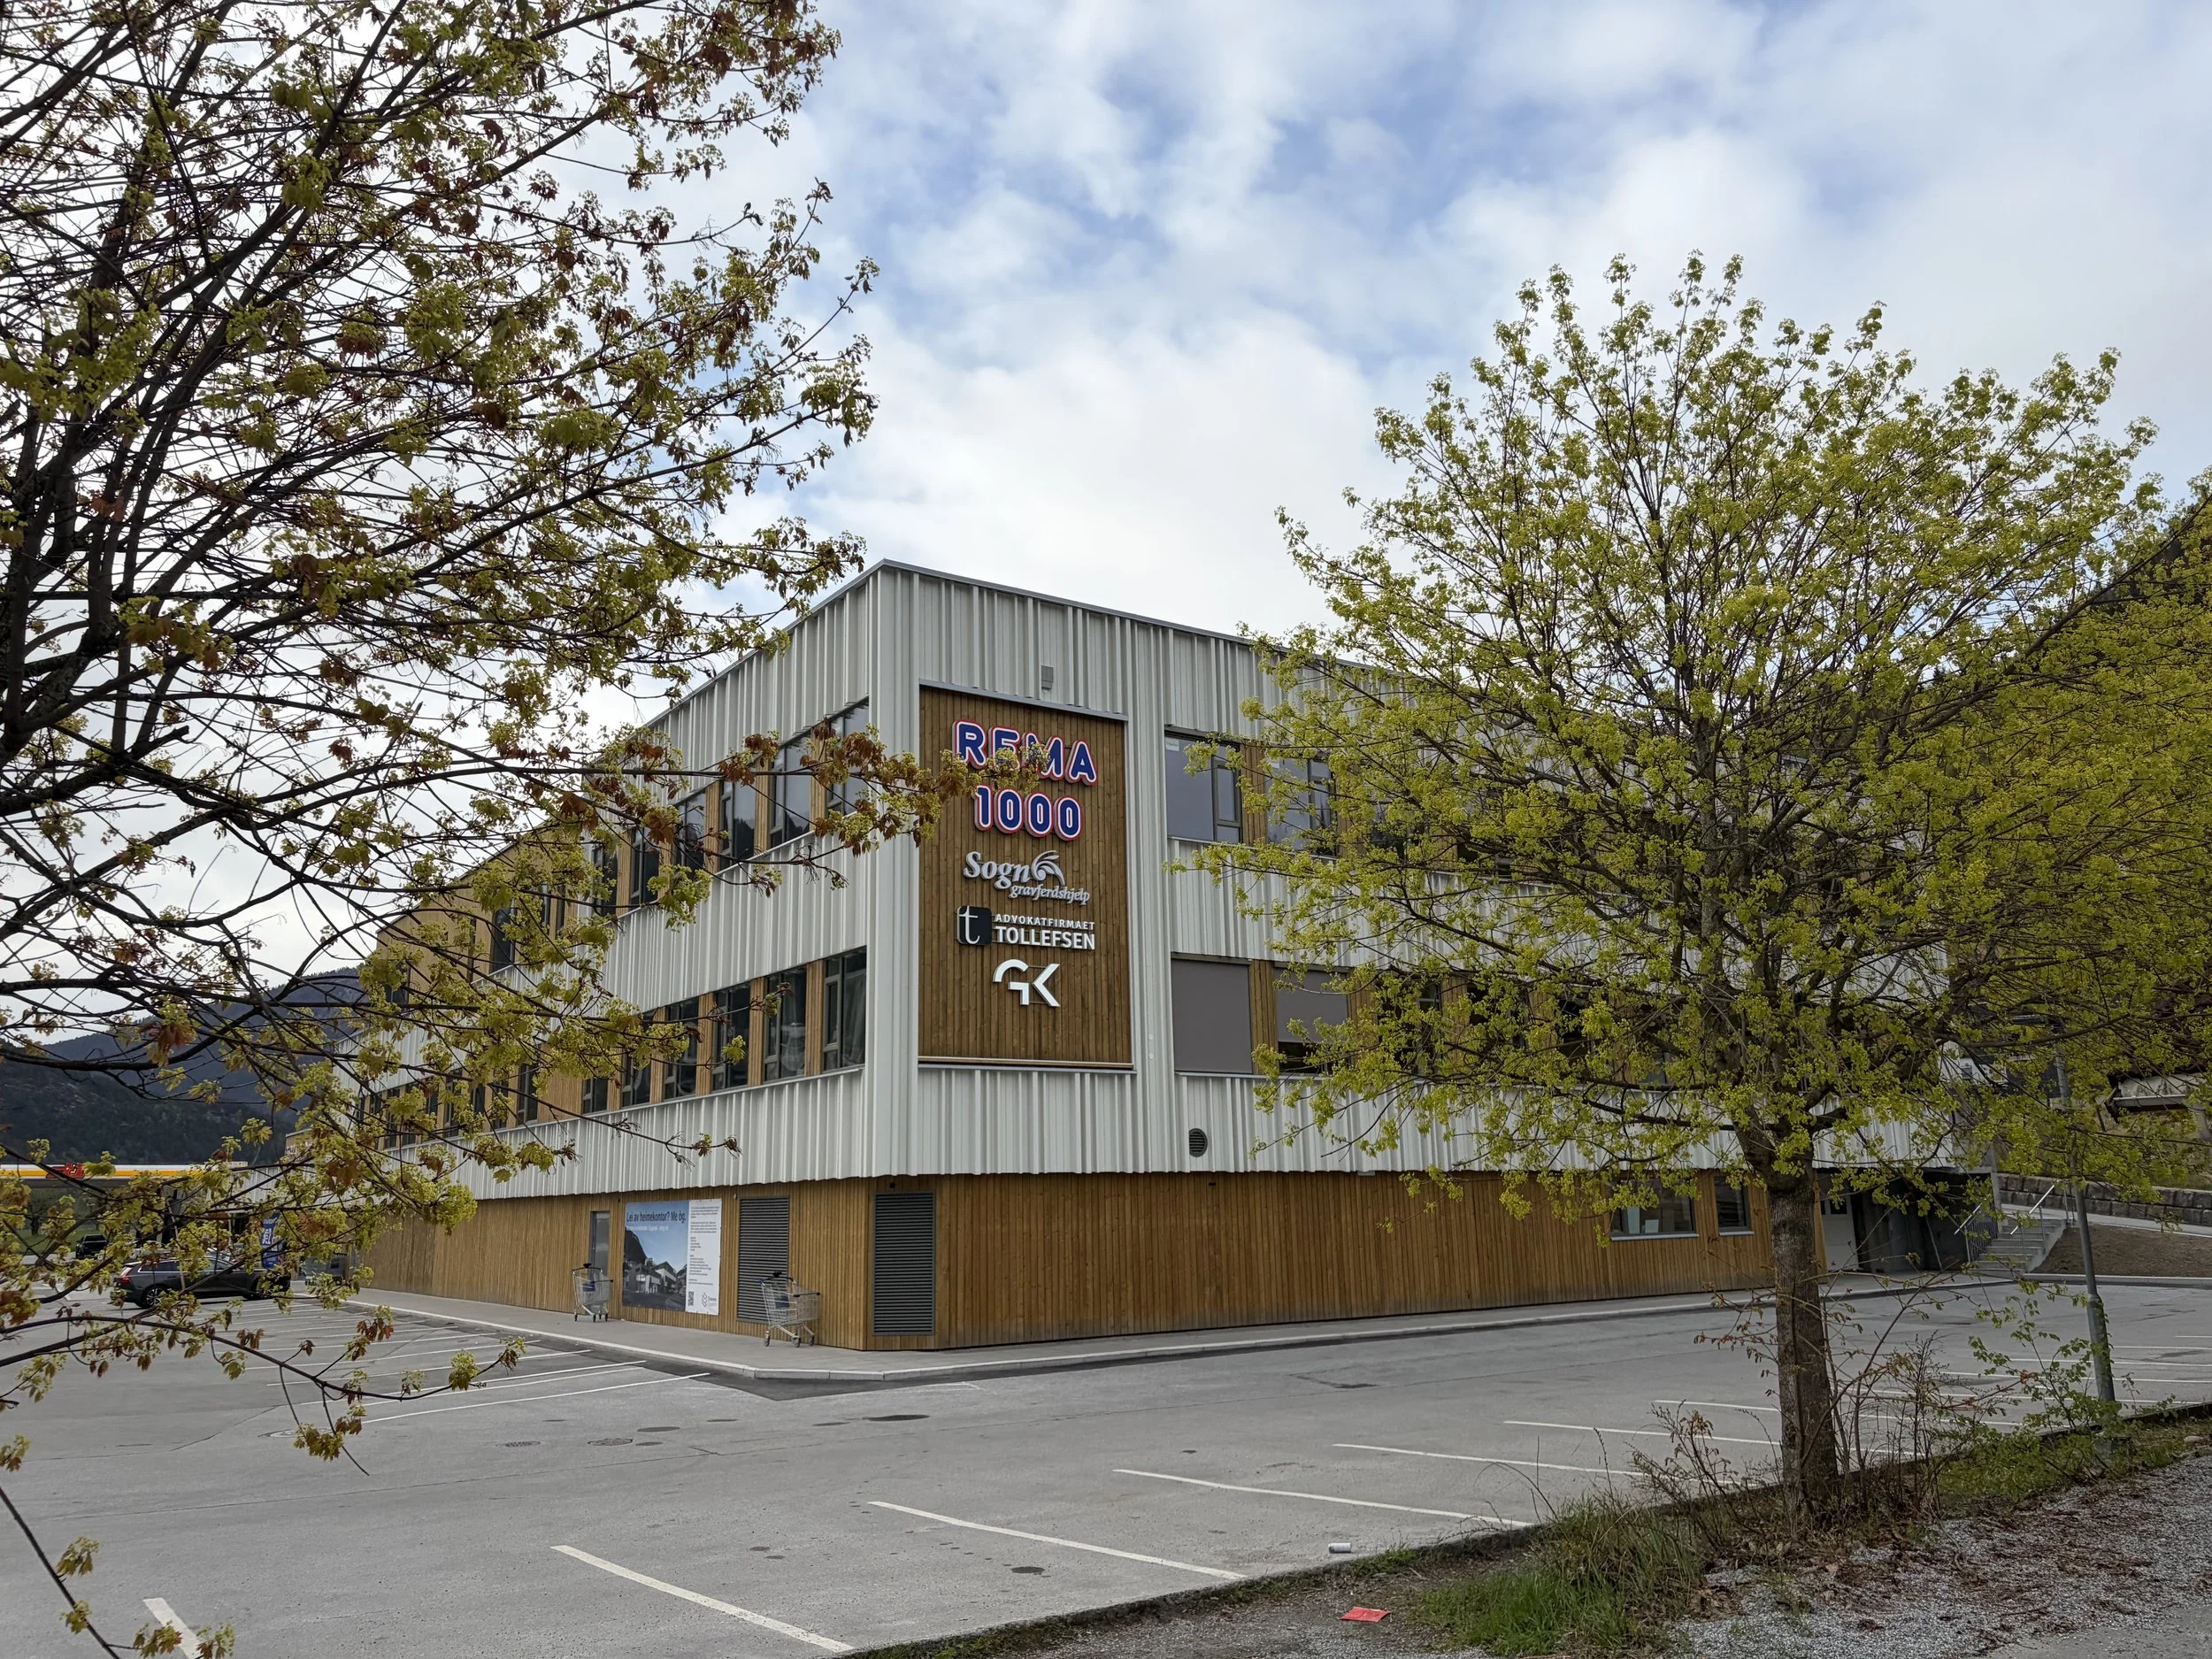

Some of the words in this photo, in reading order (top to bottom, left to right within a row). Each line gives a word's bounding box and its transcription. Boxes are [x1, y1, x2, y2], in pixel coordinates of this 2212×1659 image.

[953, 719, 1097, 786] REMA
[972, 784, 1083, 841] 1000
[964, 851, 1031, 890] Sogn
[1008, 884, 1090, 905] gravferdshjelp
[995, 913, 1095, 930] ADVOKATFIRMAET
[995, 926, 1095, 950] TOLLEFSEN
[993, 958, 1061, 1008] GK
[639, 1210, 670, 1222] heimekontor?
